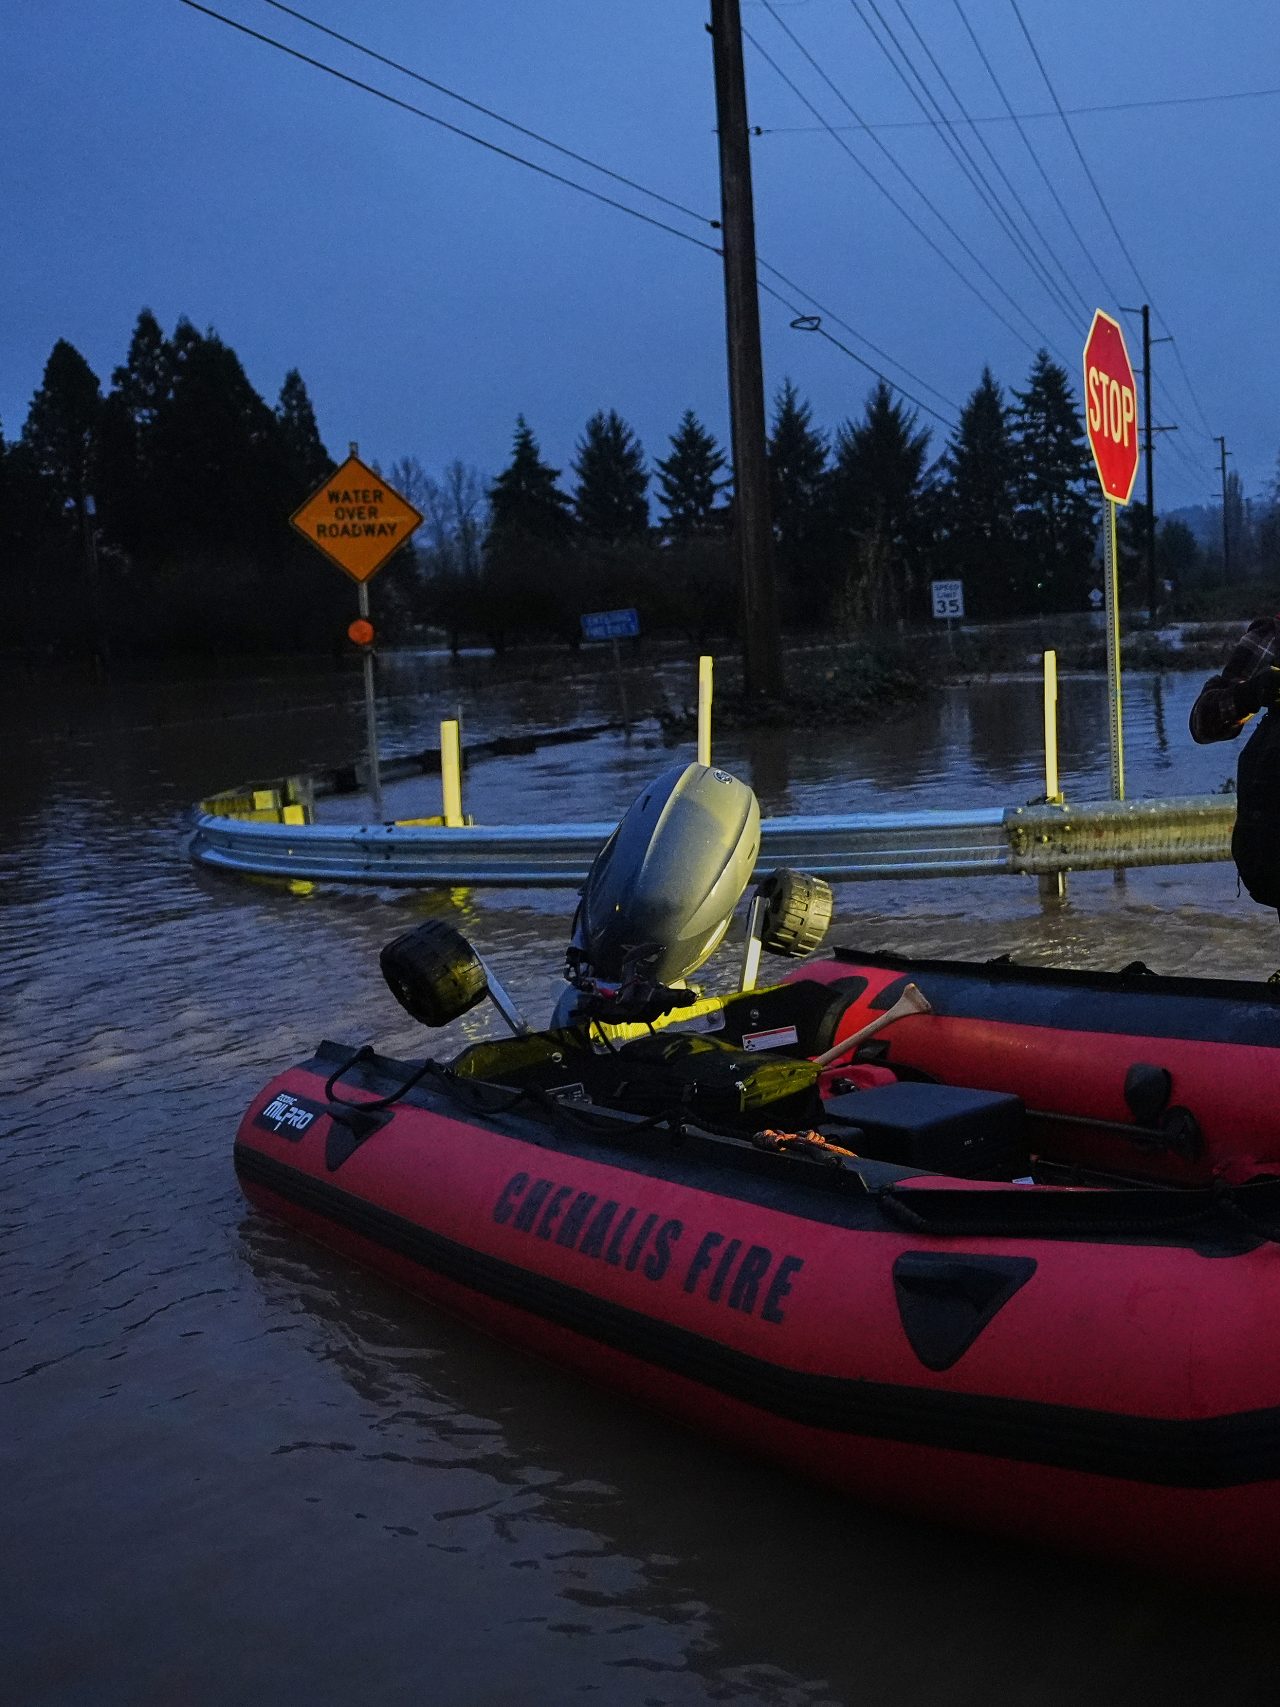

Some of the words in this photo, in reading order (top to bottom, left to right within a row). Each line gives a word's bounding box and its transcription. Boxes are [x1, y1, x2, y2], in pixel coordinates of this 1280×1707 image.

[1088, 366, 1134, 448] STOP
[327, 489, 384, 504] WATER
[335, 506, 378, 520] OVER
[316, 523, 398, 538] ROADWAY
[936, 600, 959, 614] 35
[492, 1172, 685, 1282] CHEHALIS
[683, 1231, 805, 1325] FIRE
